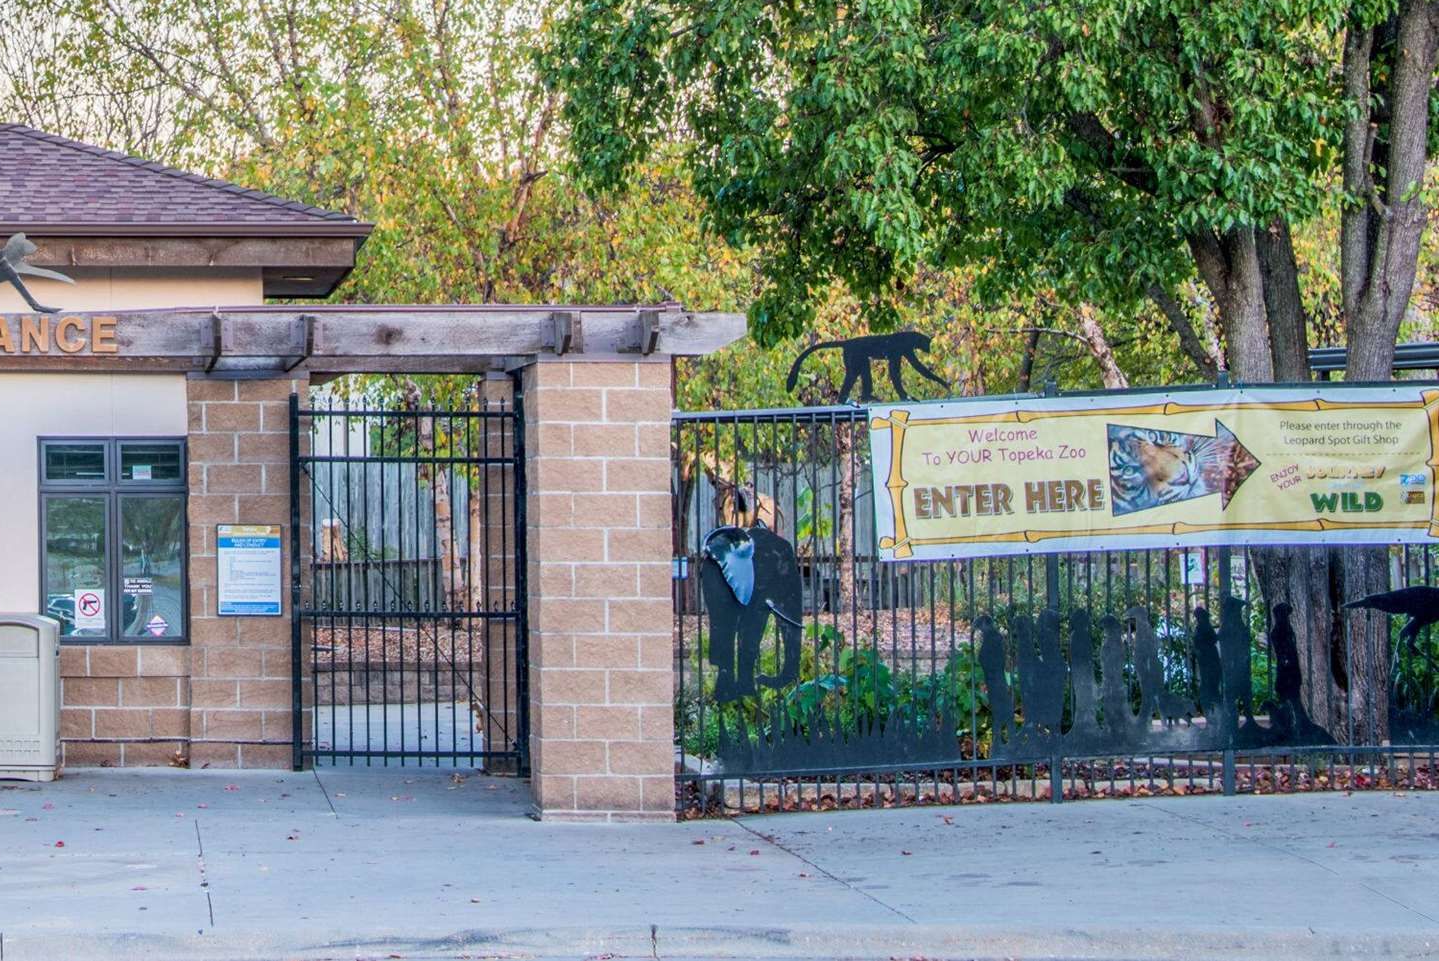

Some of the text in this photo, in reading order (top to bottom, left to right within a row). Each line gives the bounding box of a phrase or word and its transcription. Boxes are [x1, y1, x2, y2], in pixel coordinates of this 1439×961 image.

[1280, 420, 1403, 433] Please enter through the
[968, 428, 1038, 443] Welcome
[1284, 434, 1399, 446] Leopard Spot Gift Shop
[922, 445, 1087, 466] To YOUR Topeka Zoo
[1270, 463, 1299, 483] ENJOY
[1277, 475, 1303, 490] YOUR
[913, 478, 1106, 520] ENTER HERE
[1310, 491, 1384, 513] WILD
